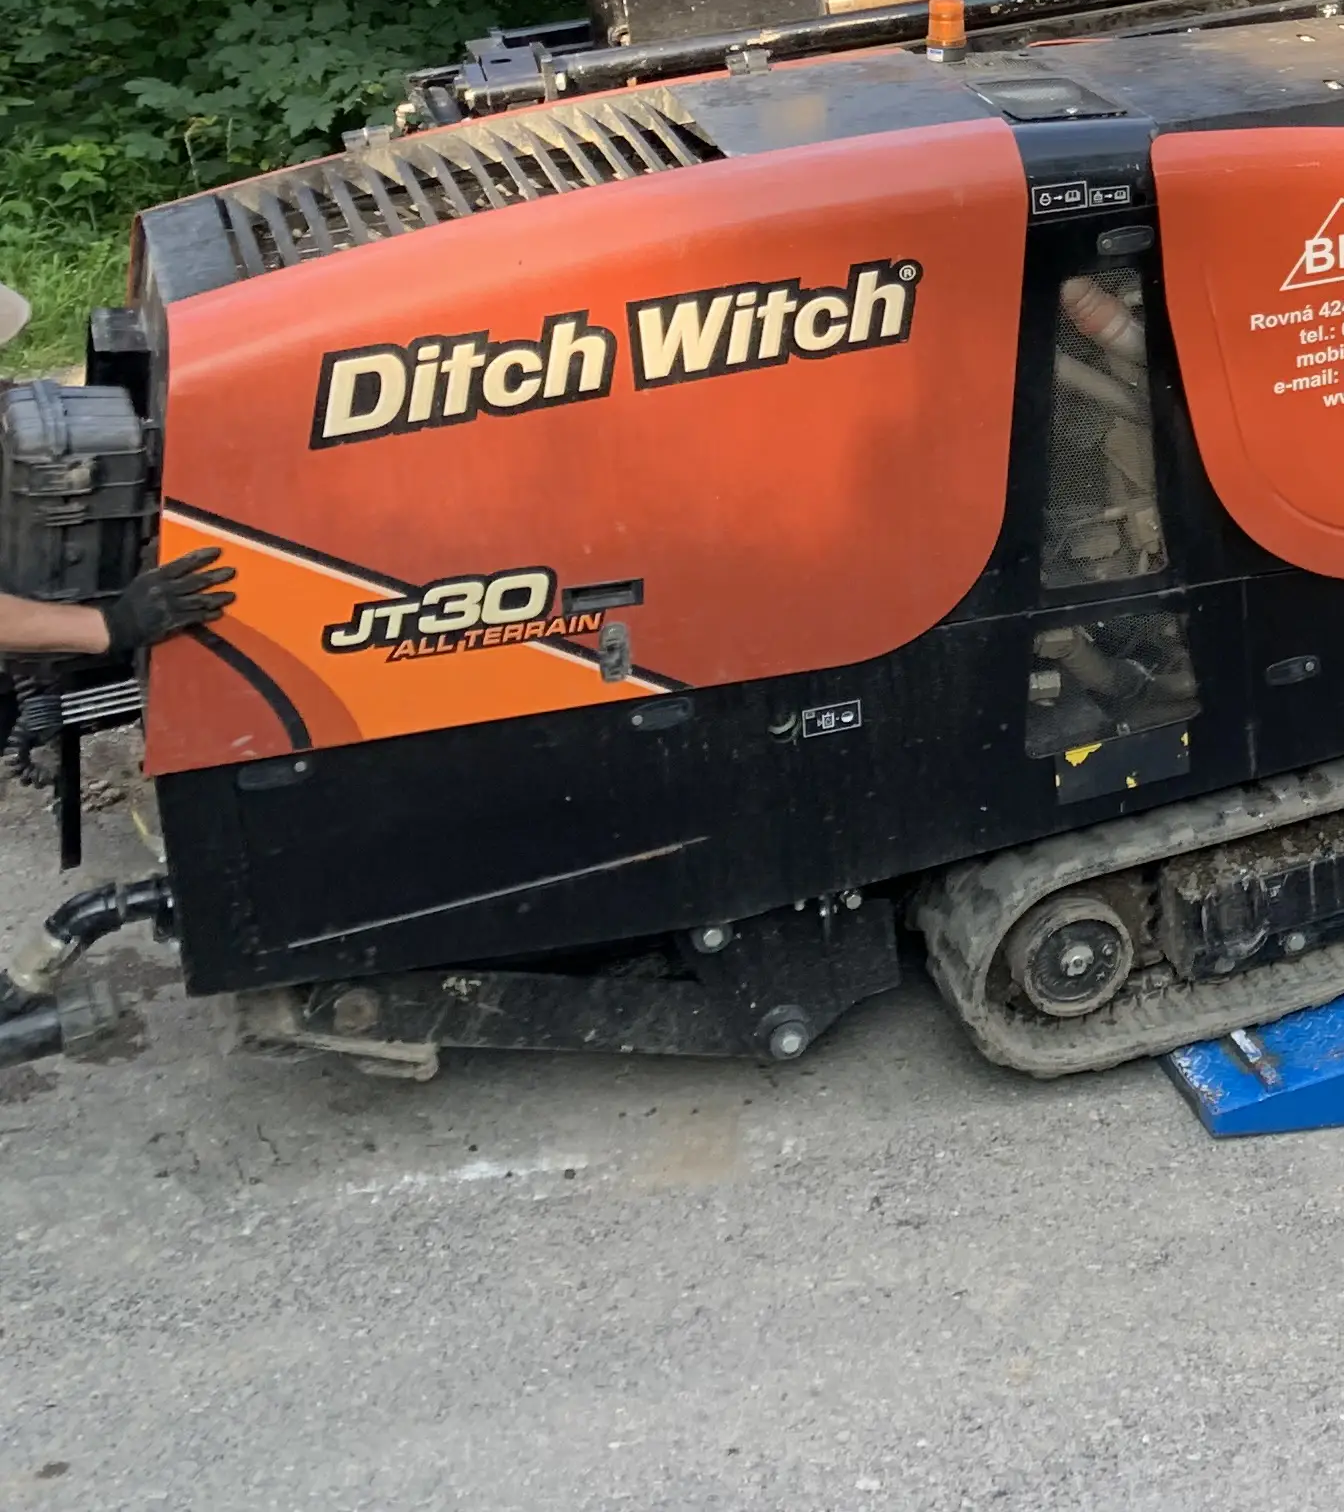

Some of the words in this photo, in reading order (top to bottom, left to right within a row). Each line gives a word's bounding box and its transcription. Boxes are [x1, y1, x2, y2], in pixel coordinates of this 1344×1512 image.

[1250, 304, 1314, 331] Rovná
[1299, 326, 1336, 345] tel.:
[321, 321, 607, 439] Ditch
[1273, 368, 1340, 395] e-mail:
[330, 573, 550, 647] JT30
[392, 635, 454, 660] ALL
[463, 612, 603, 646] TERRAIN
